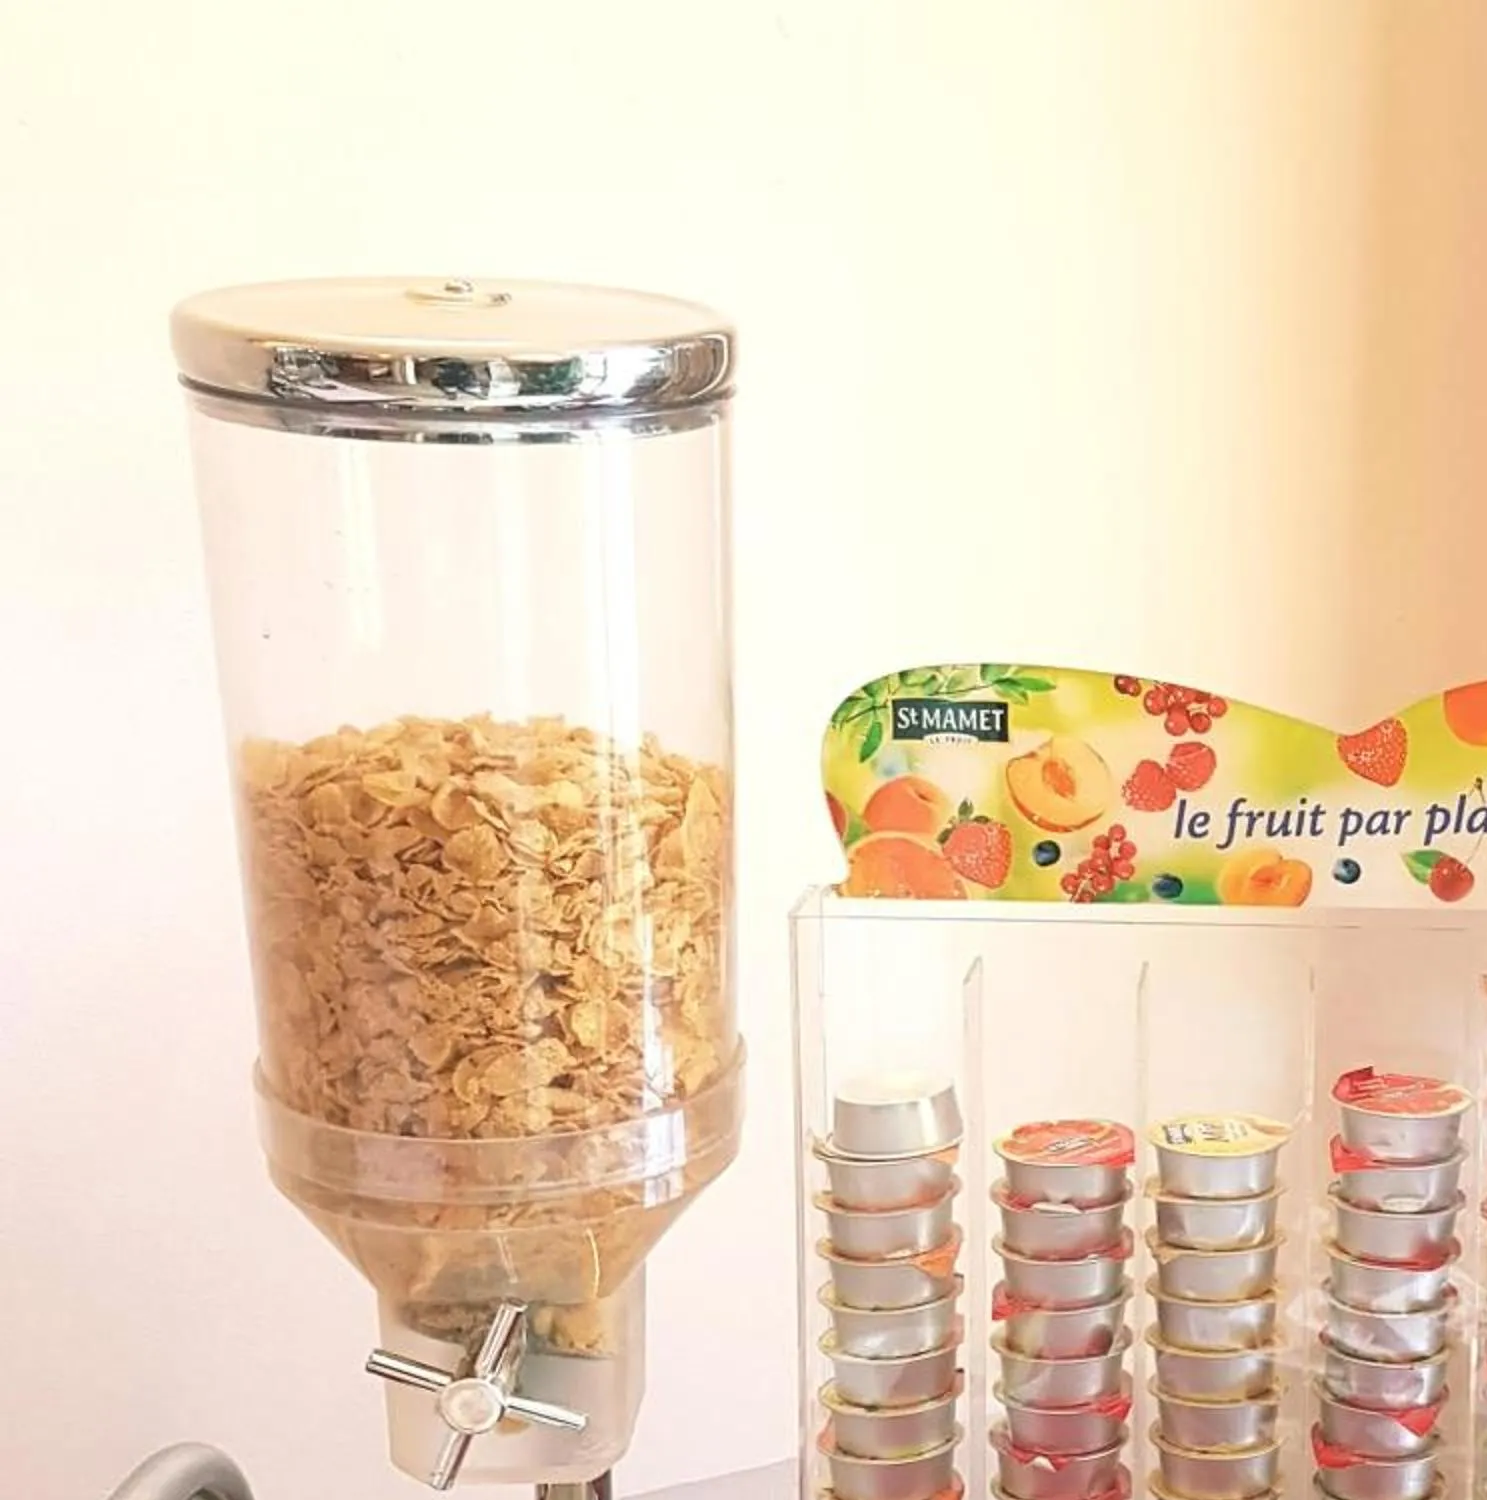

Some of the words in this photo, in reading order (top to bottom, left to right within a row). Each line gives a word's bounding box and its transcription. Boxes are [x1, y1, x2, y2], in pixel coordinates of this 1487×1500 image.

[897, 707, 918, 729] St
[921, 707, 1004, 731] MAMET
[1174, 799, 1211, 838] le
[1216, 797, 1326, 849] fruit
[1338, 807, 1411, 846] par
